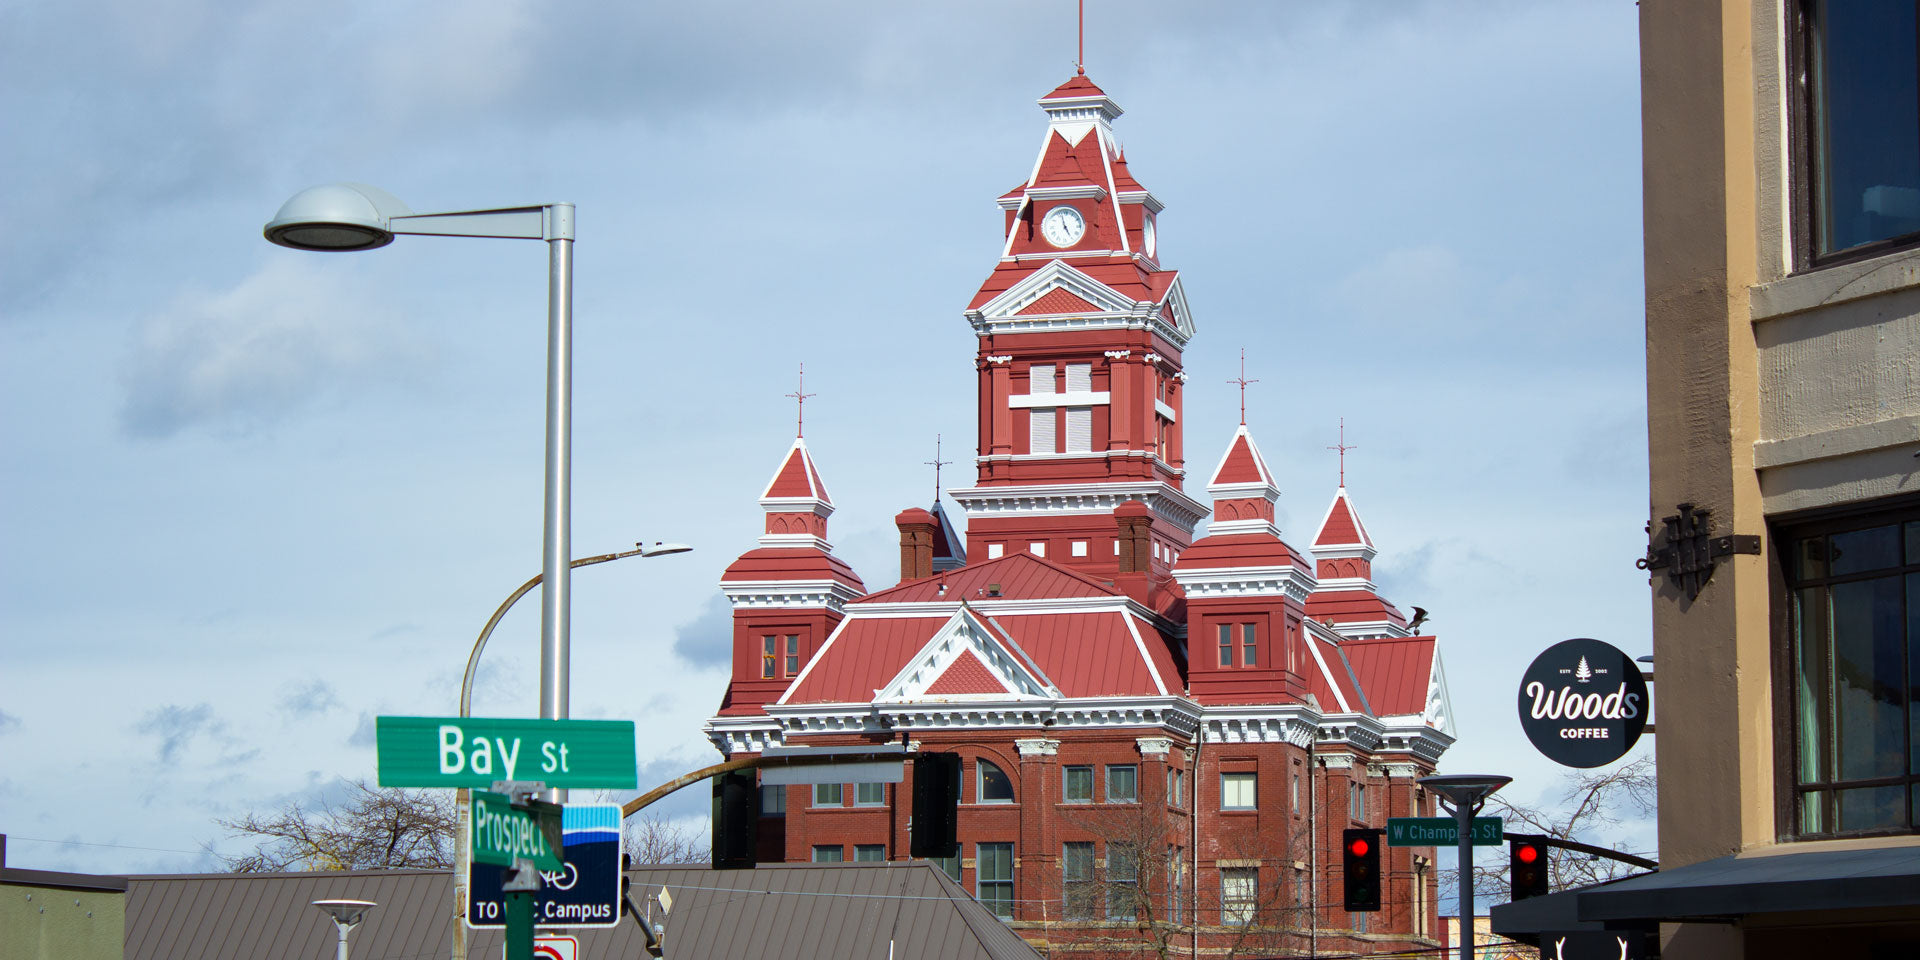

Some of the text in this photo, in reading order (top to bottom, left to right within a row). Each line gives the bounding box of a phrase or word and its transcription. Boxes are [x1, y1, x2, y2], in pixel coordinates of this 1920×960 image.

[1526, 681, 1640, 720] Woods
[1559, 728, 1609, 739] COFFEE
[439, 725, 569, 780] Bay St
[476, 799, 546, 869] Prospect
[1393, 825, 1497, 841] W Champin St
[476, 901, 499, 919] TO
[544, 900, 611, 922] Campus
